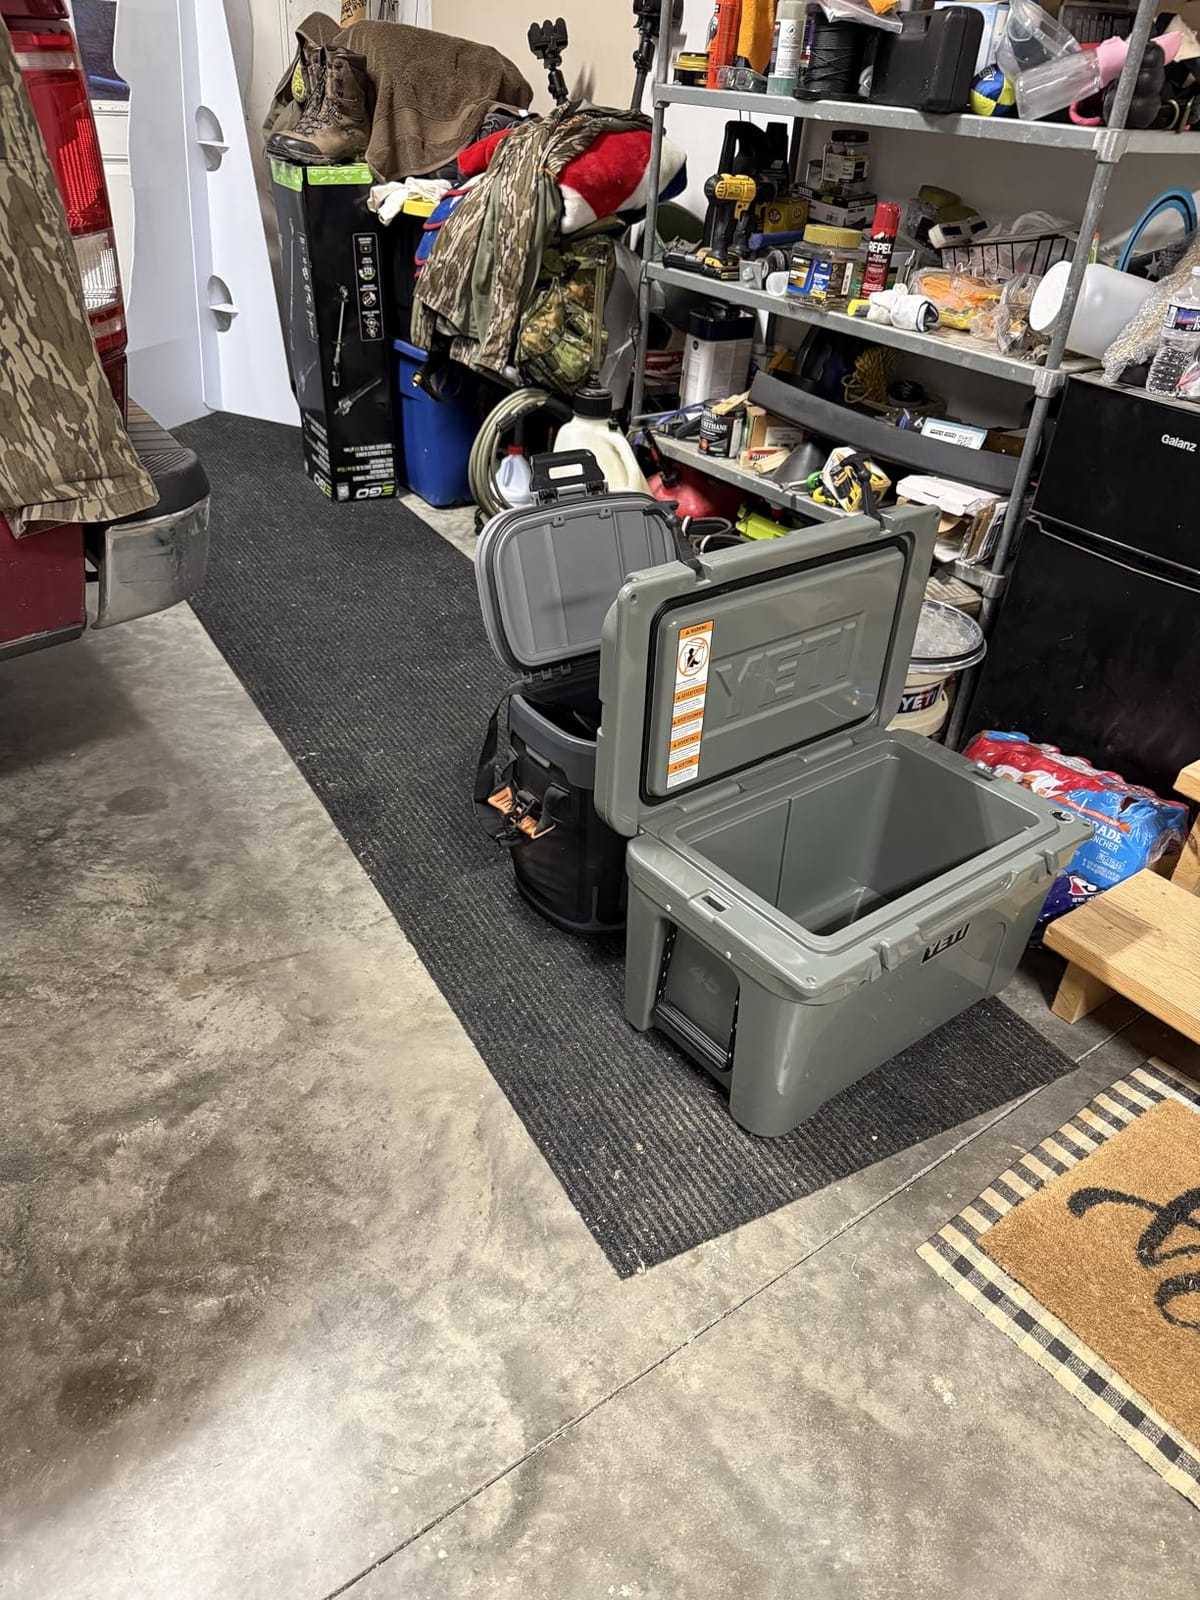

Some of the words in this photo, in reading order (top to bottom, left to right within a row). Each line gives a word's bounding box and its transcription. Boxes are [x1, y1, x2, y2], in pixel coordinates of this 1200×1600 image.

[868, 240, 892, 254] REPEL
[1161, 433, 1198, 452] Galanz
[355, 484, 395, 499] EGO
[714, 621, 857, 720] YETI
[900, 688, 938, 711] YETI
[1091, 820, 1123, 844] RADE
[1091, 834, 1120, 853] NCHER
[926, 922, 965, 960] YETI
